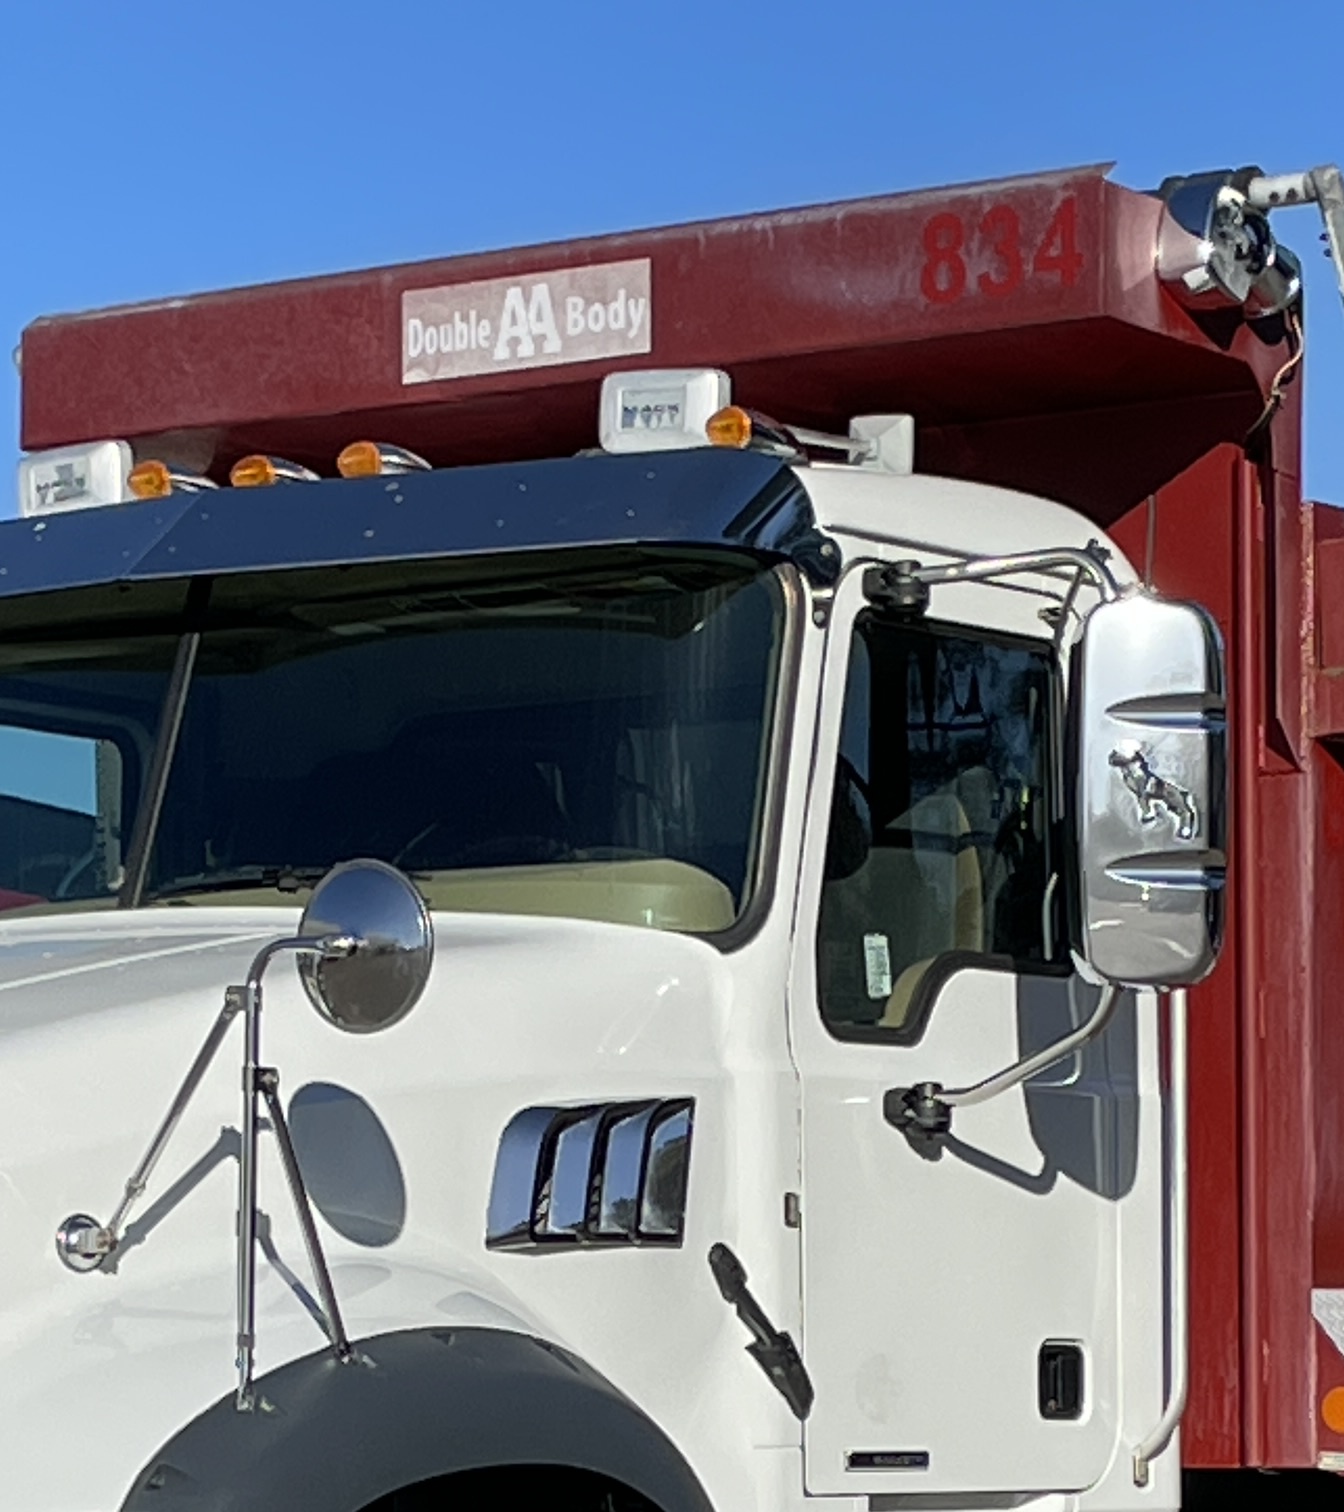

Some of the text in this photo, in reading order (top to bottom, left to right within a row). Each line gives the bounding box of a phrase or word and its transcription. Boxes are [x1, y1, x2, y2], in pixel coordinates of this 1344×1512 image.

[920, 195, 1085, 304] 834
[408, 308, 492, 358] Double
[565, 287, 646, 340] Body
